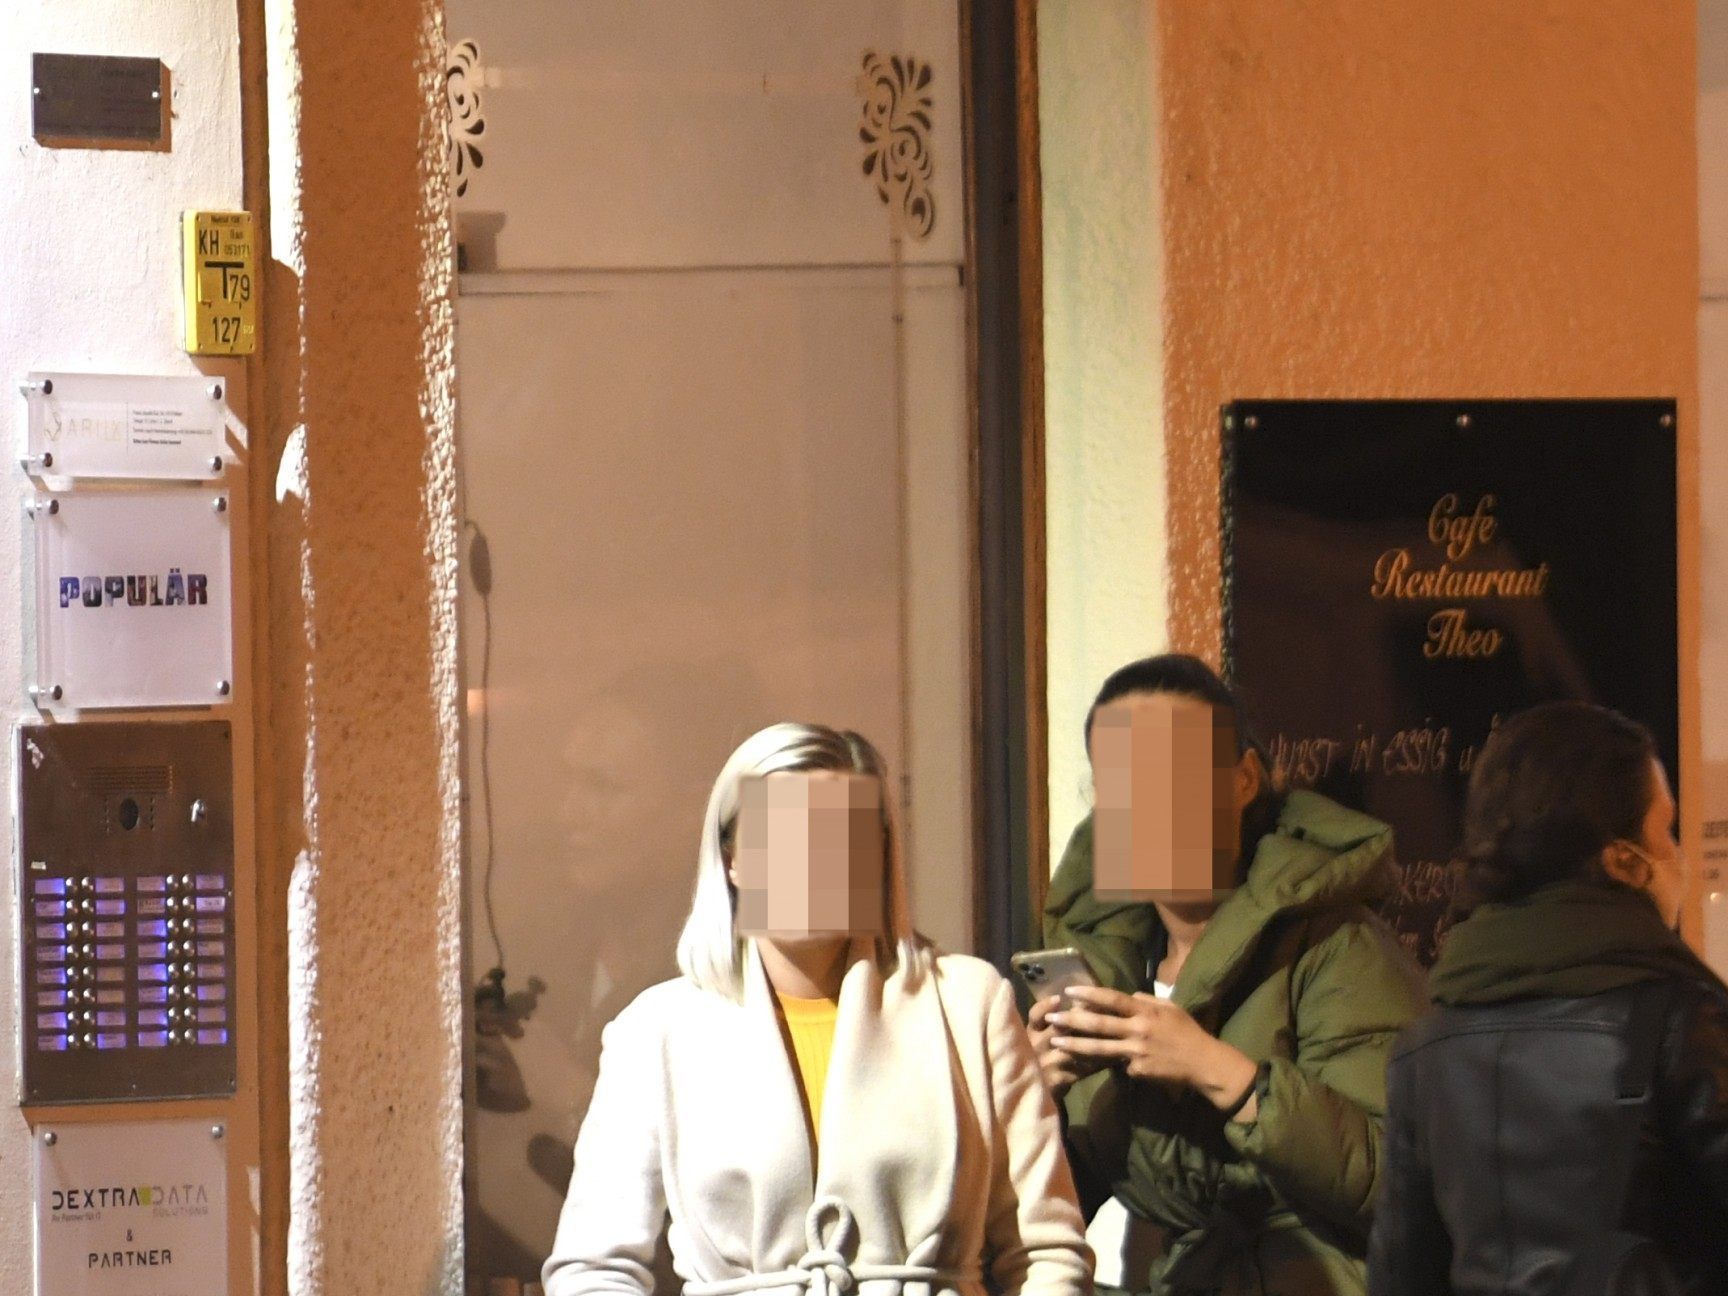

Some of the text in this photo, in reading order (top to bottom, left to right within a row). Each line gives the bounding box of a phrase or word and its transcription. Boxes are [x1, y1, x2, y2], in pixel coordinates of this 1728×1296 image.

[198, 229, 219, 256] KH
[212, 316, 241, 343] 127
[59, 568, 208, 608] POPULÄR
[1371, 548, 1548, 598] Restaurant
[1422, 608, 1503, 658] Theo
[88, 1249, 172, 1269] PARTNER
